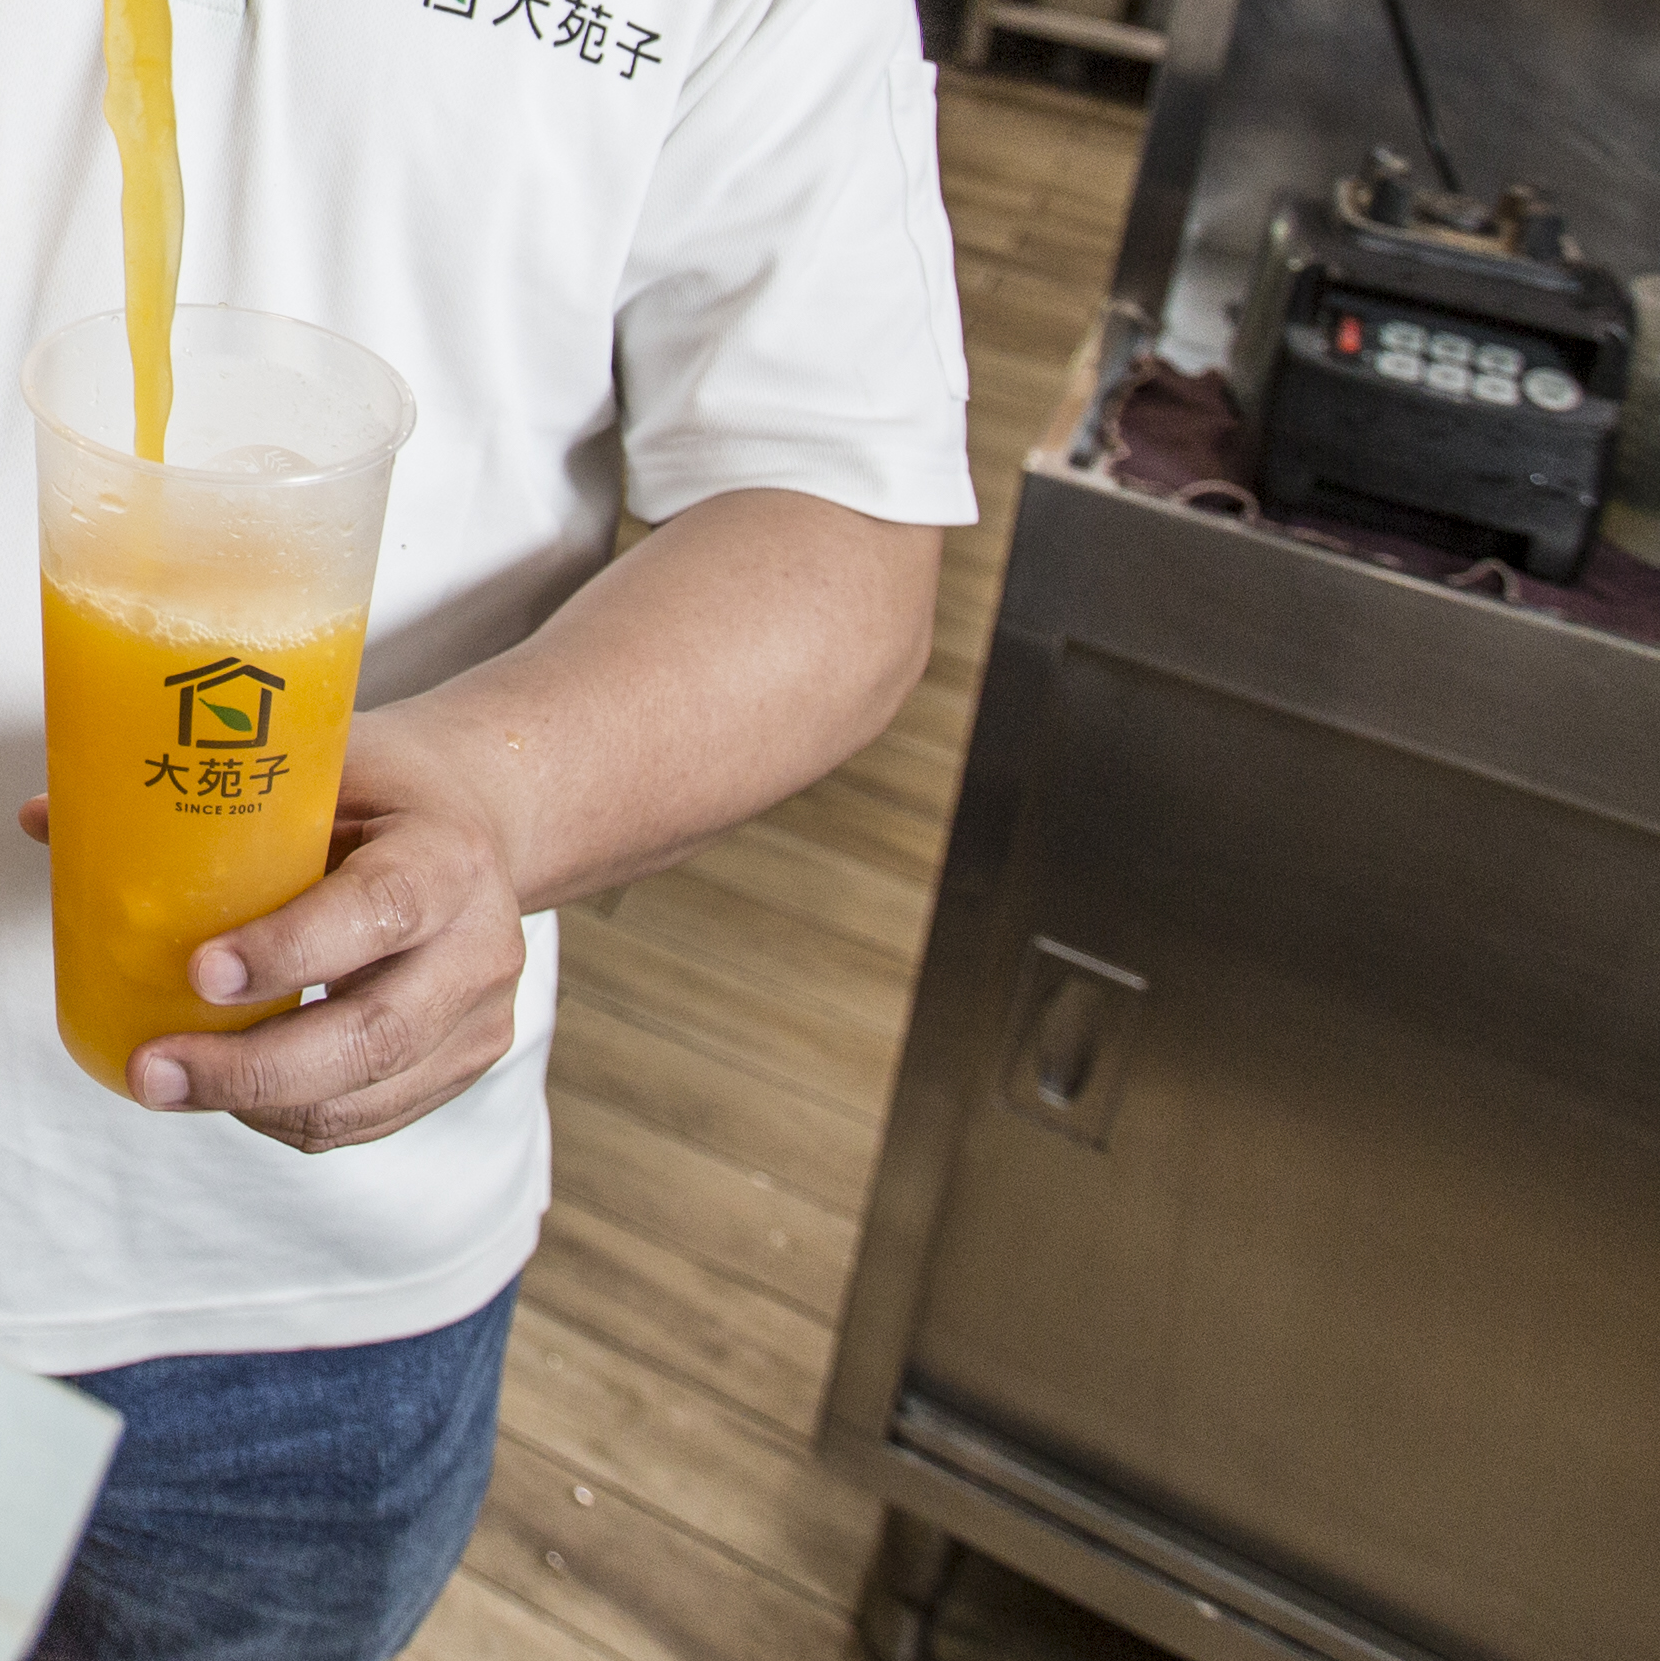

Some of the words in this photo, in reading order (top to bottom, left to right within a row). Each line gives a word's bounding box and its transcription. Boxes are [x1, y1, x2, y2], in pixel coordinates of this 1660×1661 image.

[144, 753, 290, 798] 大苑子
[175, 801, 222, 815] SINCE
[229, 802, 263, 815] 2001
